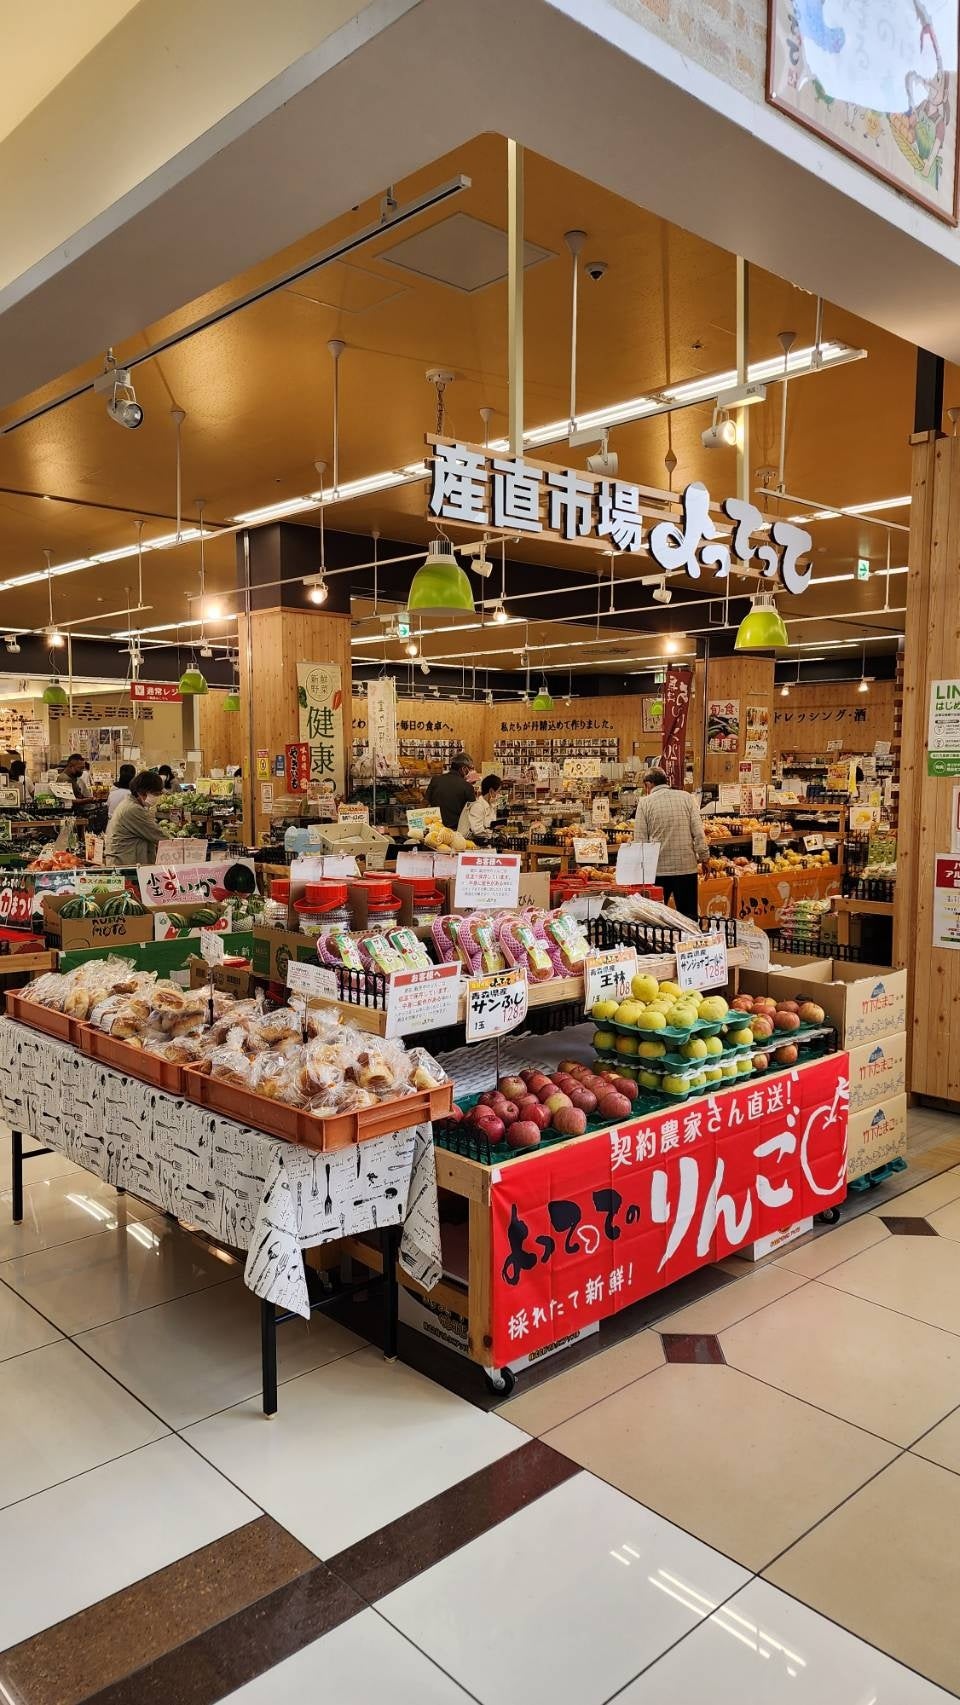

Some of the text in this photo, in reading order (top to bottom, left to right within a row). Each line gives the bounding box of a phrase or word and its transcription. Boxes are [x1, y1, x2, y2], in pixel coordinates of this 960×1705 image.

[430, 443, 643, 551] 産直市場
[472, 992, 524, 1014] サンふじ
[600, 970, 626, 988] 王林
[611, 1082, 791, 1168] 契約農家さん直送!
[640, 1104, 799, 1272] りんご
[507, 1263, 634, 1341] 採れたて新鮮!
